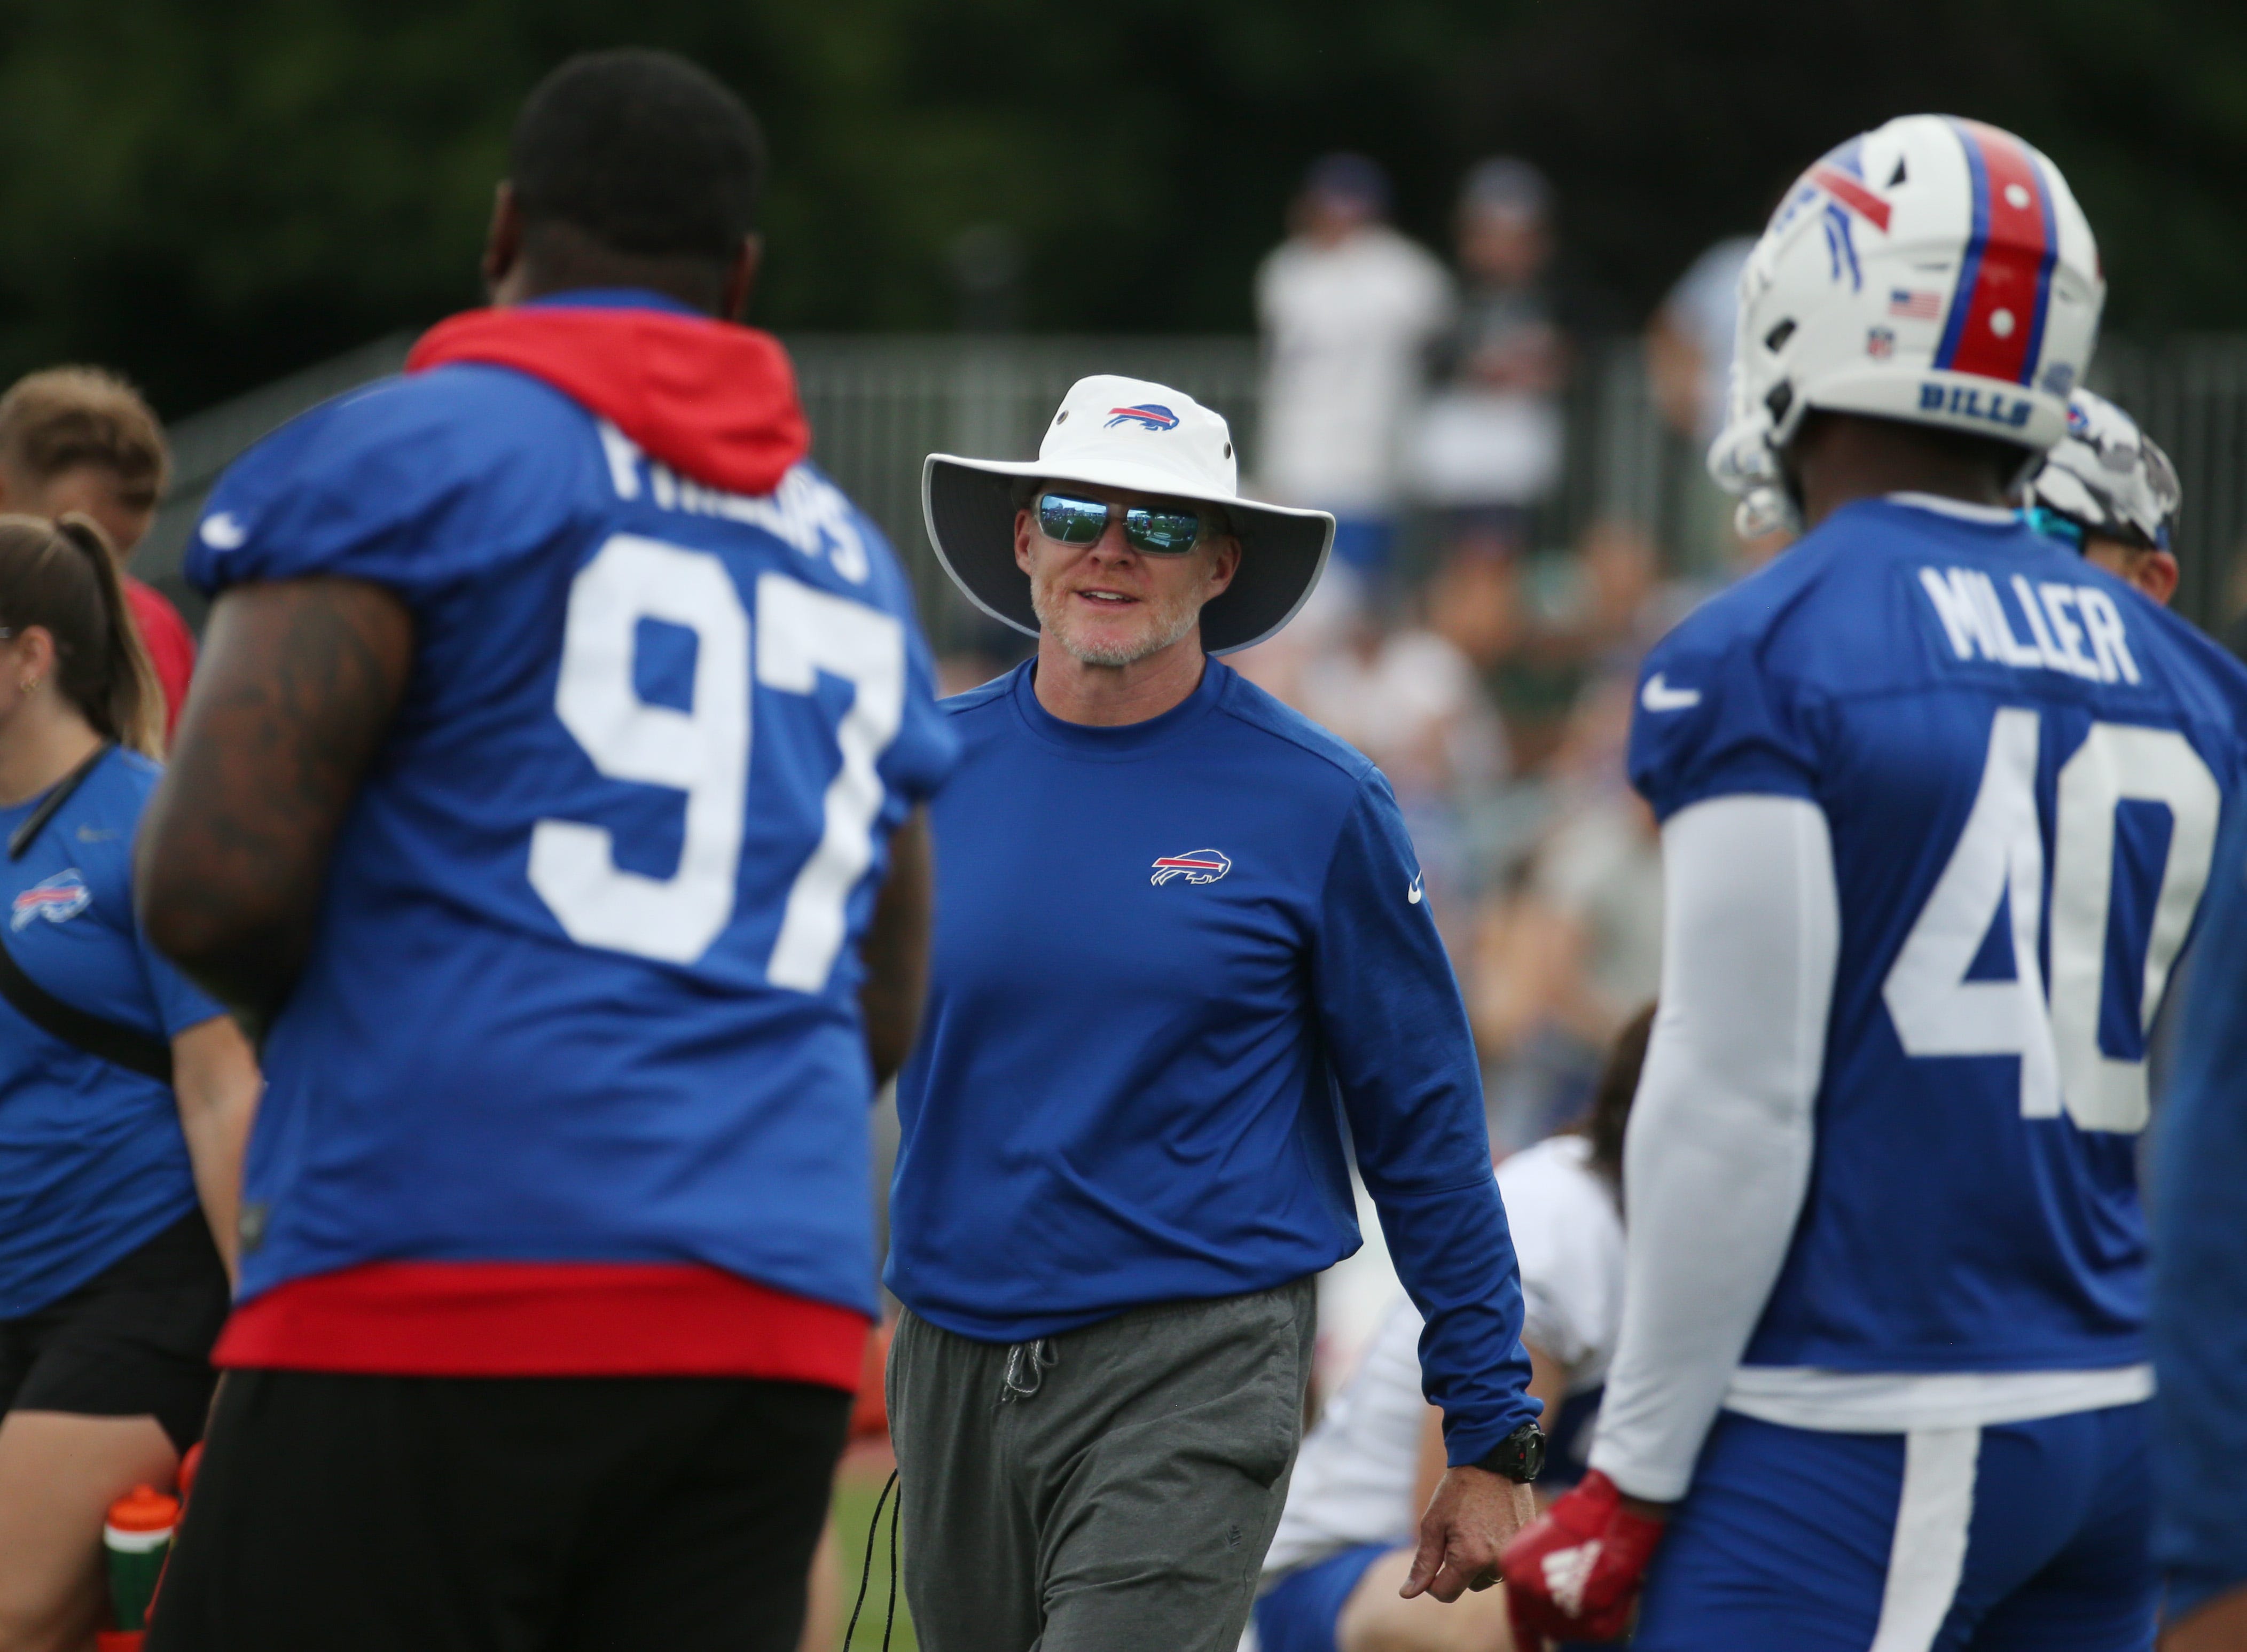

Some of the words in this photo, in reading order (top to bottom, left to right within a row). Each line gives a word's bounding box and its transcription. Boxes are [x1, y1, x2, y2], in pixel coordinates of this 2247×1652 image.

[1920, 382, 2033, 429] BILLS
[1919, 566, 2141, 686] MILLER
[527, 533, 905, 994] 97
[1882, 706, 2221, 1134] 40
